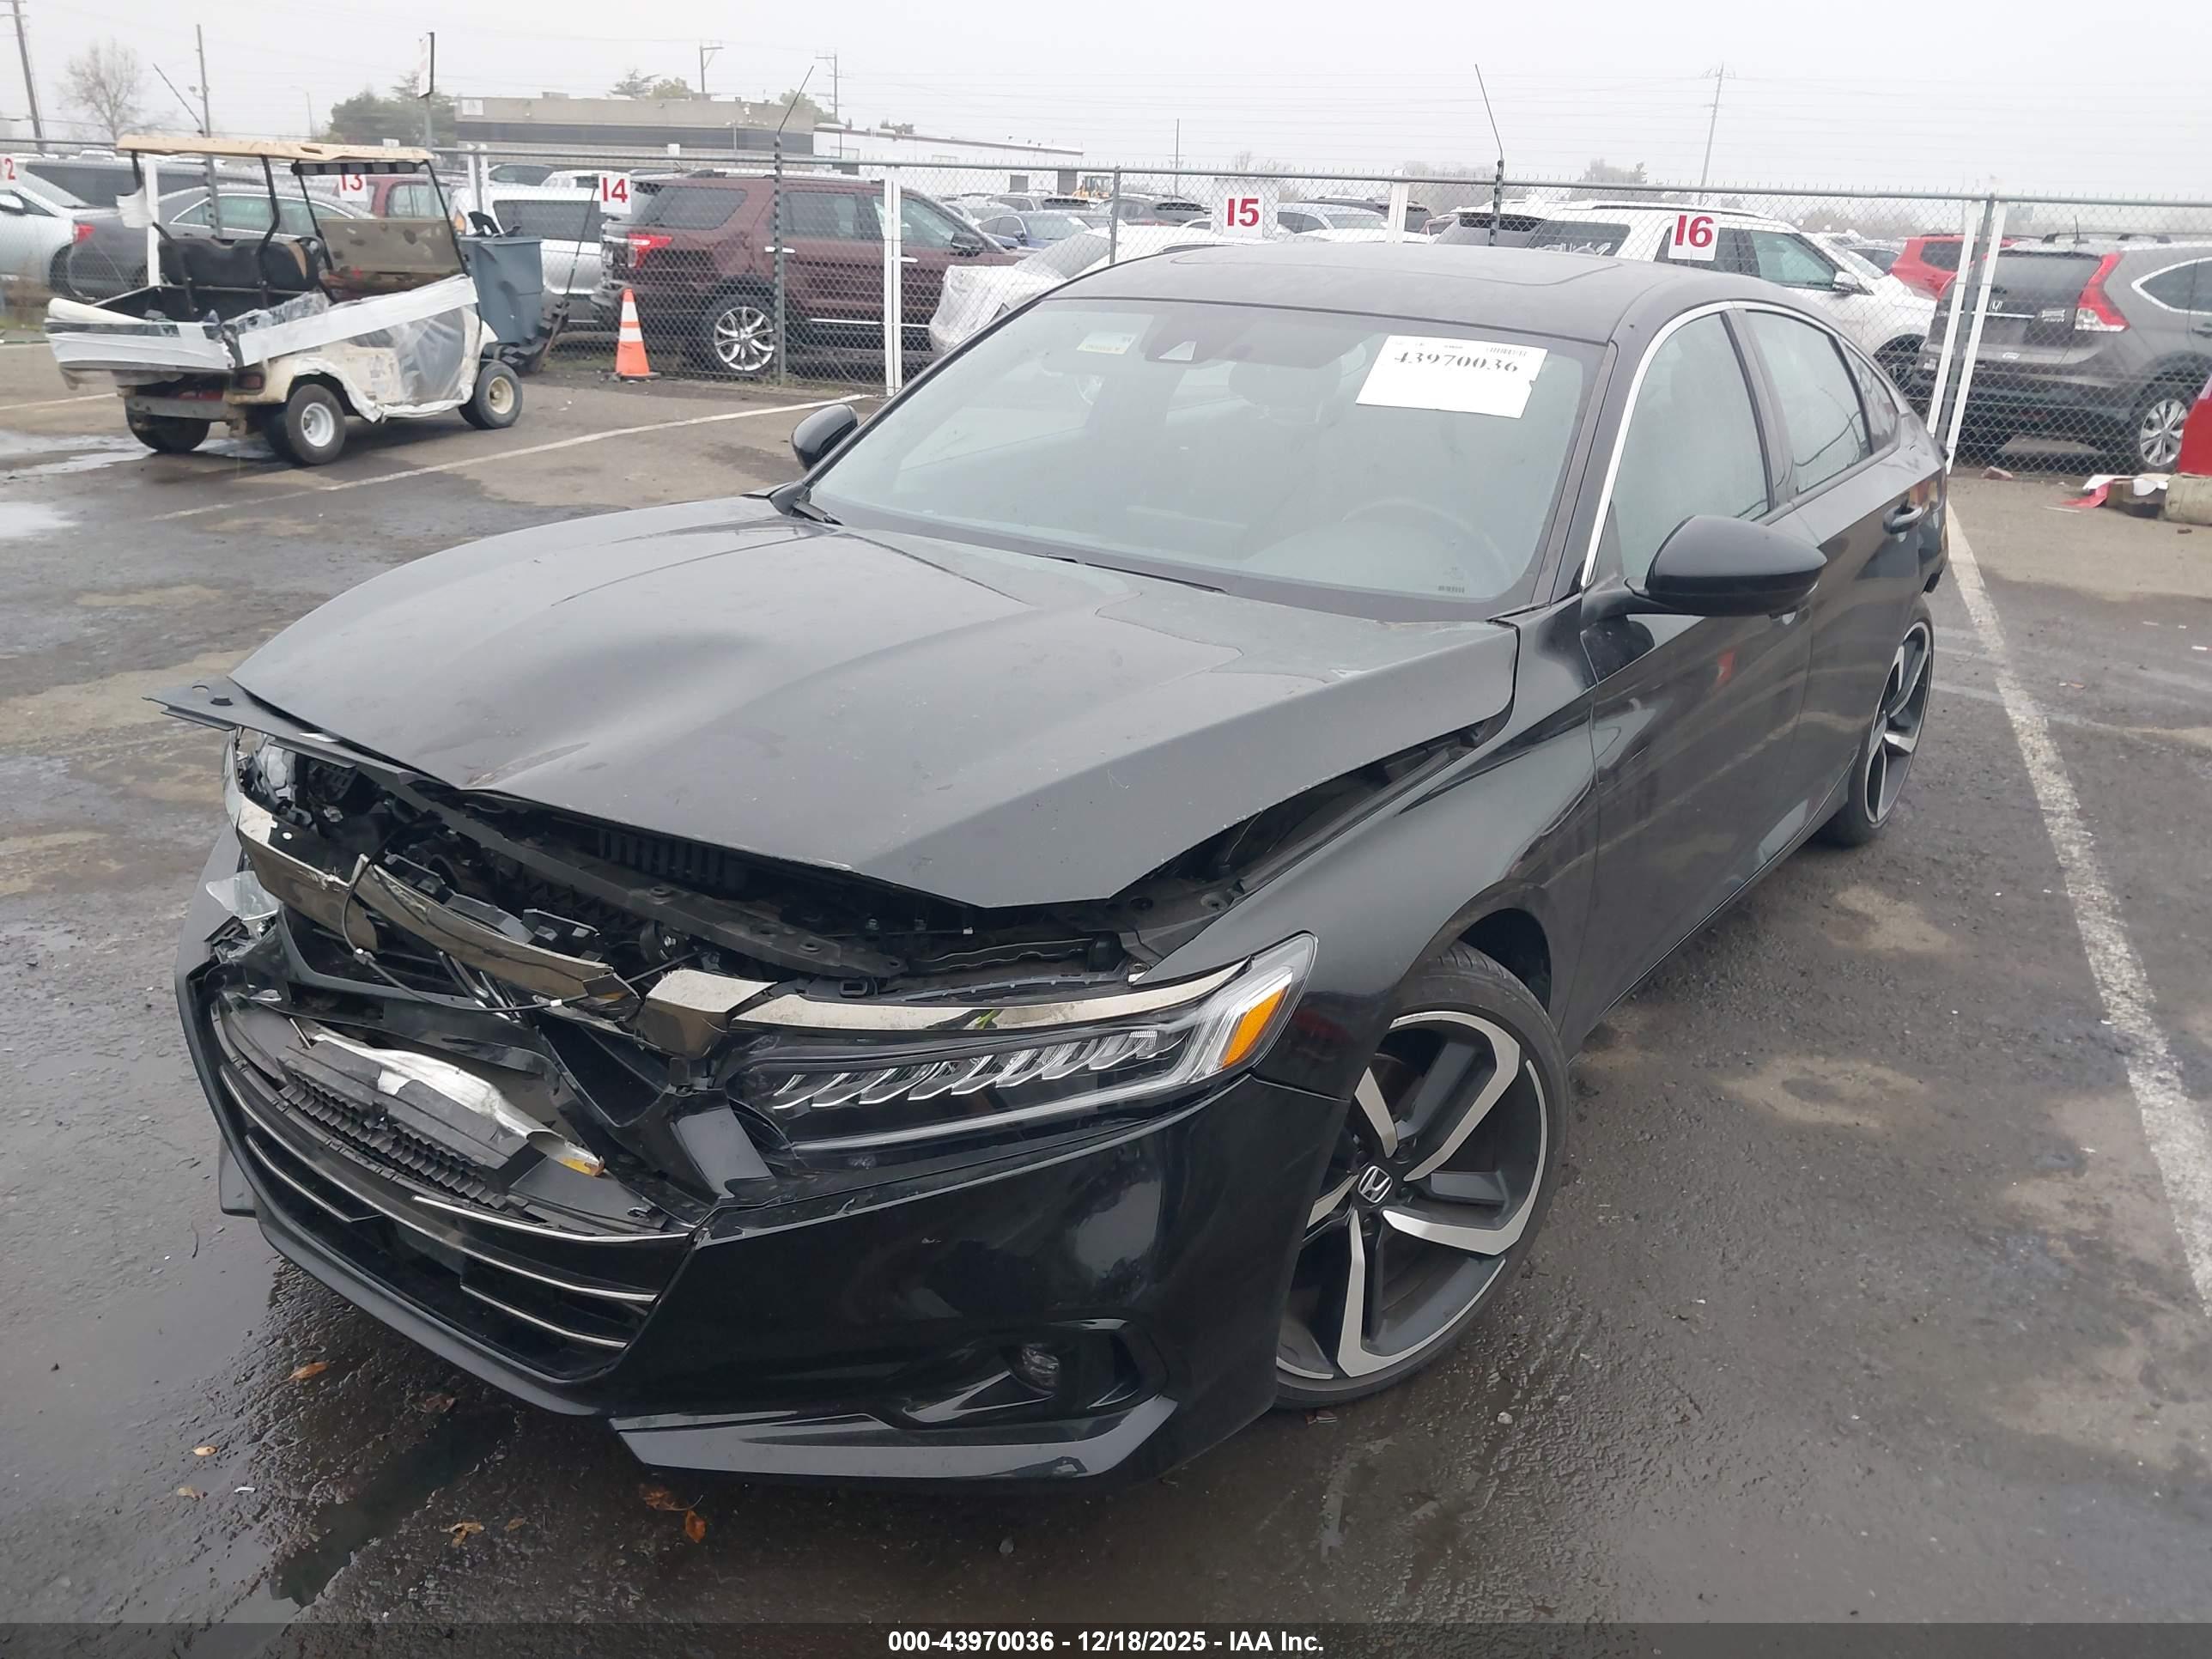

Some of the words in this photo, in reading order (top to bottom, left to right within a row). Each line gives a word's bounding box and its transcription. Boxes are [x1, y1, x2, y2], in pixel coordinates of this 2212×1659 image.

[0, 158, 15, 180] 2
[603, 177, 628, 203] 14
[1228, 198, 1259, 227] 15
[1675, 215, 1714, 247] 16
[1395, 351, 1518, 373] 43970036
